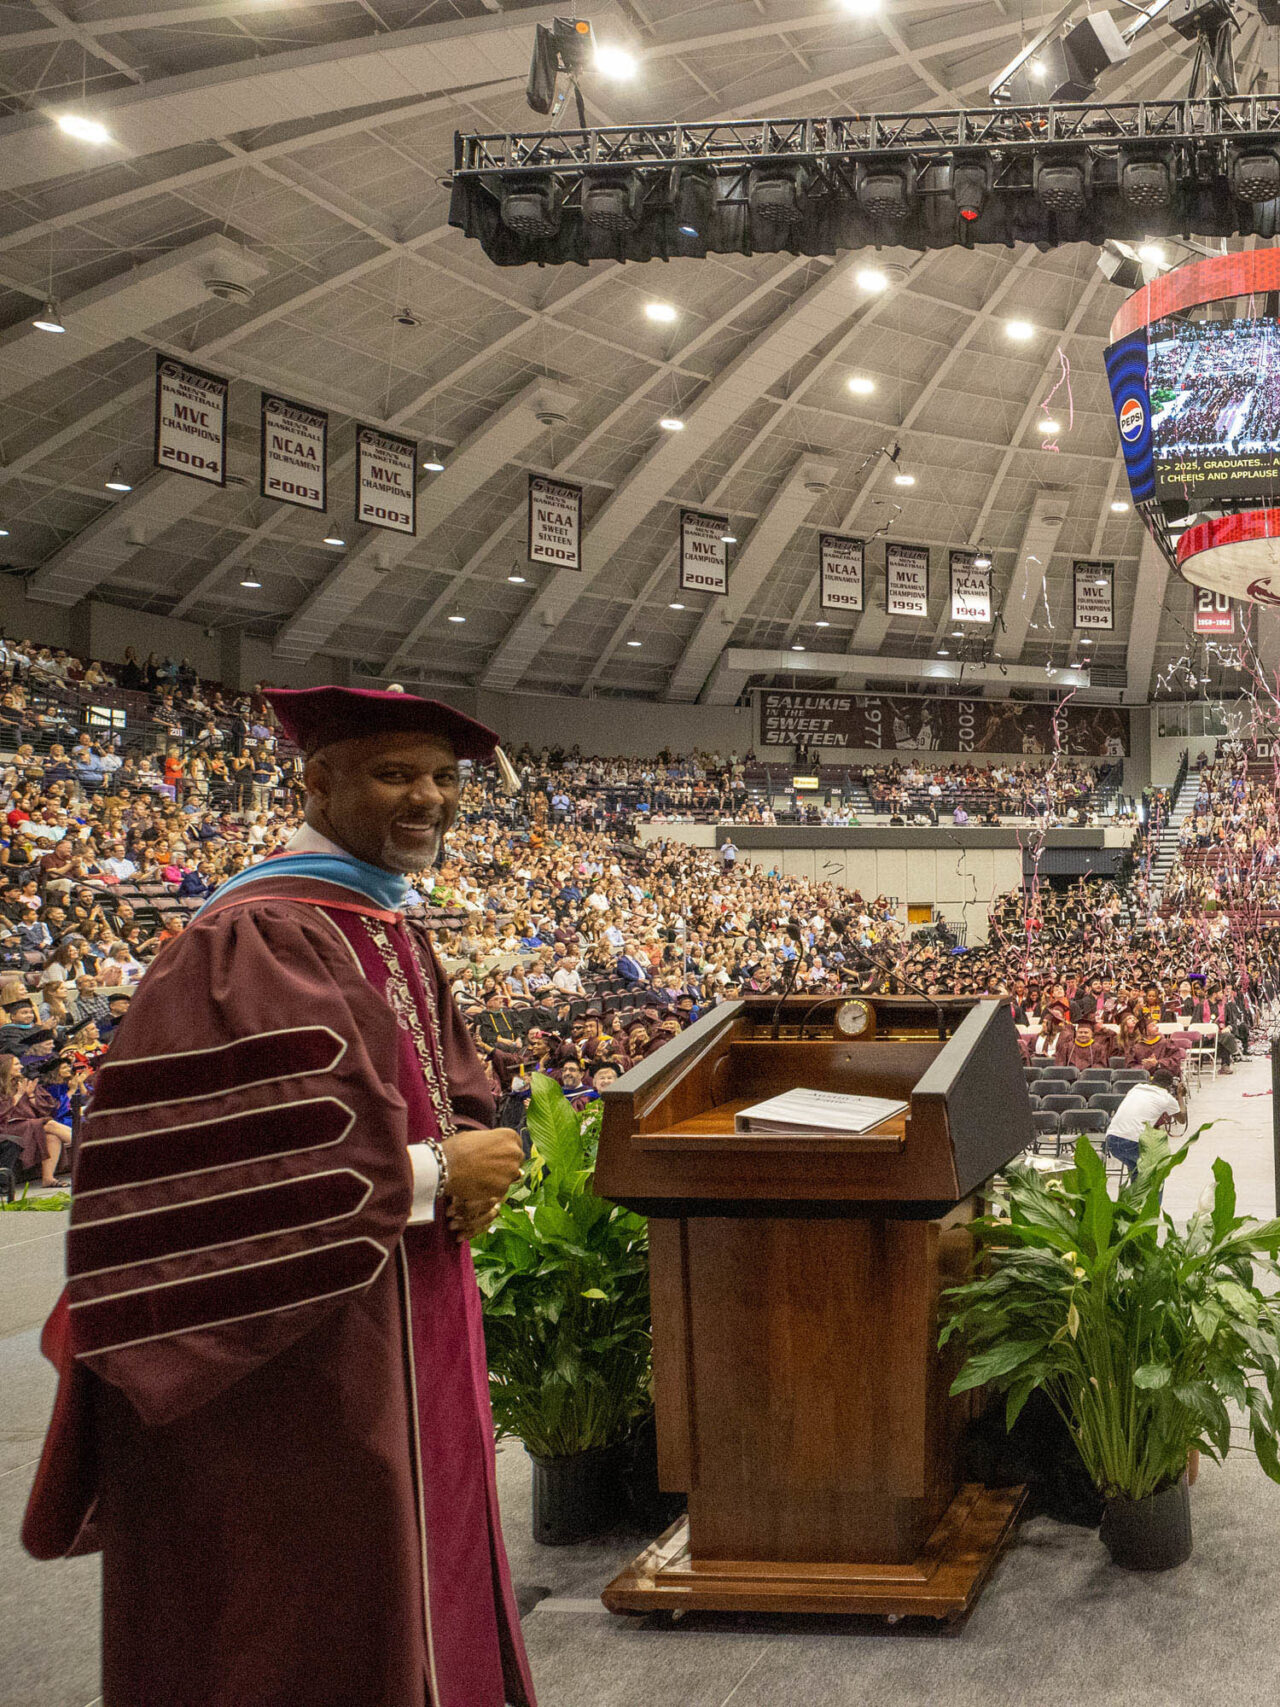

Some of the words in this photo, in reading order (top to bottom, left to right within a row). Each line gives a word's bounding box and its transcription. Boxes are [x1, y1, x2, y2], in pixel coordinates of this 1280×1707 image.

[162, 385, 221, 410] BASKETBALL
[173, 402, 209, 428] MVC
[1121, 412, 1143, 429] PEPSI
[162, 416, 220, 443] CHAMPIONS
[267, 420, 321, 441] BASKETBALL
[272, 434, 317, 461] NCAA
[162, 445, 219, 473] 2004
[268, 450, 320, 472] TOURNAMENT
[361, 450, 411, 469] BASKETBALL
[1174, 460, 1201, 472] 2025,
[1203, 458, 1270, 470] GRADUATES...
[371, 465, 402, 486] MVC
[1167, 473, 1205, 483] CHEERS
[1207, 471, 1228, 480] AND
[1230, 469, 1278, 479] APPLAUSE
[269, 477, 320, 501] 2003
[361, 478, 412, 499] CHAMPIONS
[363, 503, 410, 525] 2003
[537, 509, 573, 528] NCAA
[541, 524, 568, 536] SWEET
[538, 532, 572, 546] SIXTEEN
[534, 544, 576, 561] 2002
[692, 541, 717, 556] MVC
[685, 552, 724, 566] CHAMPIONS
[827, 563, 857, 576] NCAA
[896, 571, 918, 583] MVC
[685, 573, 724, 587] 2002
[825, 574, 860, 584] TOURNAMENT
[890, 582, 925, 591] TOURNAMENT
[827, 593, 858, 604] 1995
[889, 590, 926, 598] CHAMPIONS
[1082, 587, 1104, 597] MVC
[893, 601, 923, 611] 1995
[1198, 590, 1230, 612] 20
[1079, 615, 1108, 624] 1994
[766, 695, 851, 711] SALUKIS
[784, 709, 805, 717] THE
[766, 717, 833, 731] SWEET
[864, 697, 882, 749] 1977
[958, 703, 975, 752] 2002
[765, 732, 849, 746] SIXTEEN
